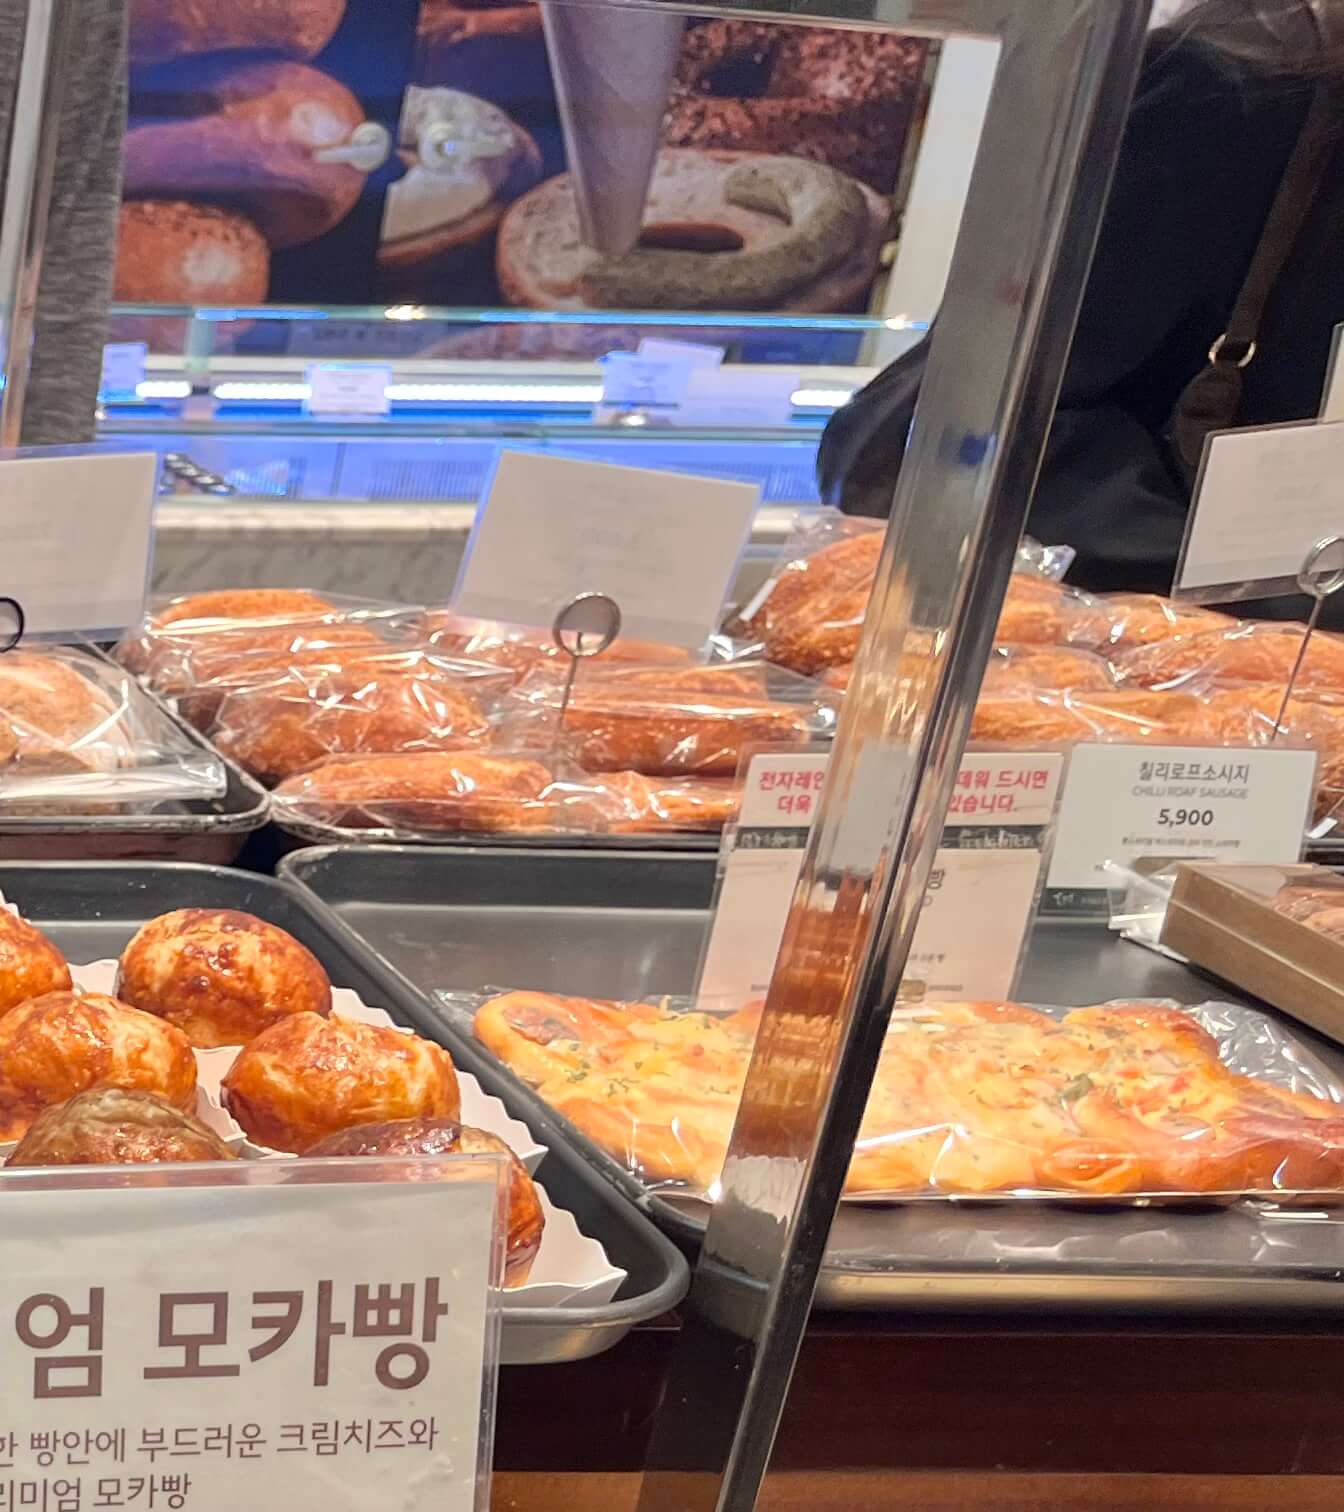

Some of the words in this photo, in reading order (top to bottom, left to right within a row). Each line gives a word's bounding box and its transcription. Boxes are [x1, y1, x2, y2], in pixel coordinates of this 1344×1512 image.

[1157, 808, 1214, 828] 5,900
[143, 1276, 449, 1391] 모카빵
[30, 1427, 126, 1467] 빵안에
[136, 1422, 268, 1463] 부드러운
[276, 1416, 440, 1456] 크림치즈와
[92, 1473, 192, 1510] 모카빵
